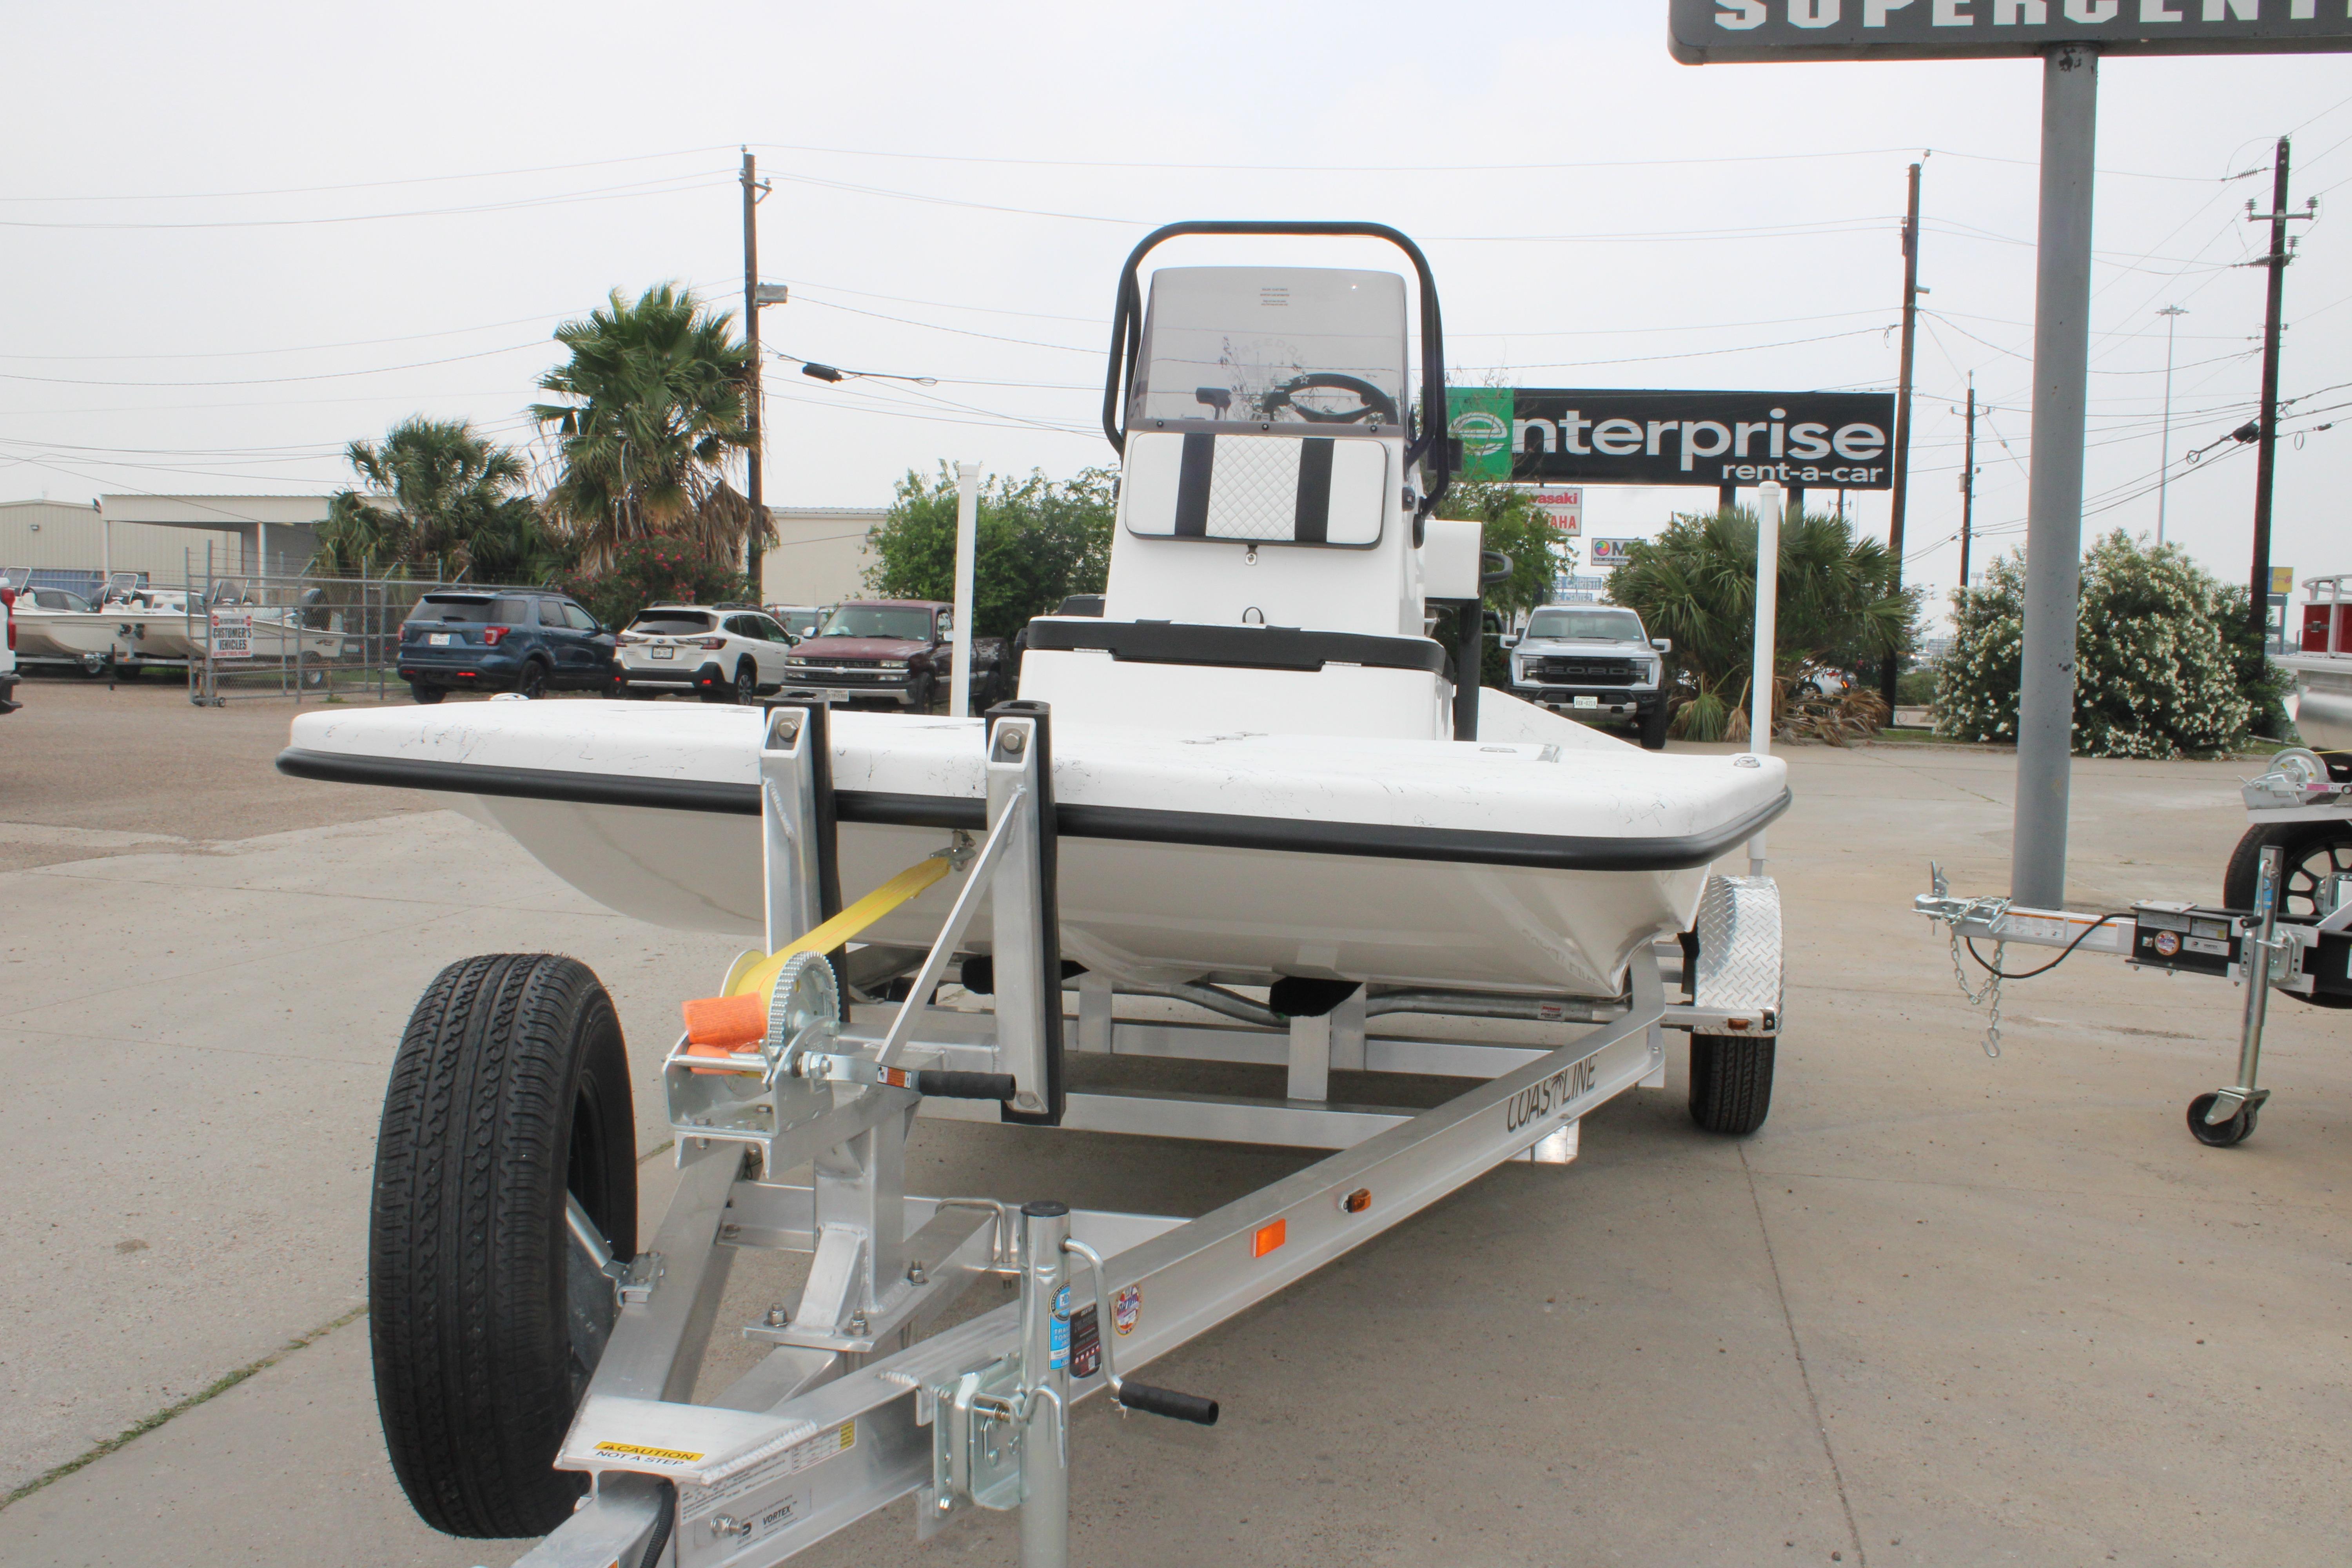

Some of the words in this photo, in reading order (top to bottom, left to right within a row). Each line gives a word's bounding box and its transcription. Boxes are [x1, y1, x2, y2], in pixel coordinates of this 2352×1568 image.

[1448, 408, 1886, 471] enterprise
[1722, 463, 1884, 482] rent-a-car
[213, 628, 252, 638] CUSTOMER'S
[219, 640, 247, 650] VEHICLES
[1545, 666, 1629, 675] FORD
[617, 1445, 694, 1459] CAUTION
[644, 1457, 684, 1466] STEP
[763, 1504, 791, 1525] VORTEX
